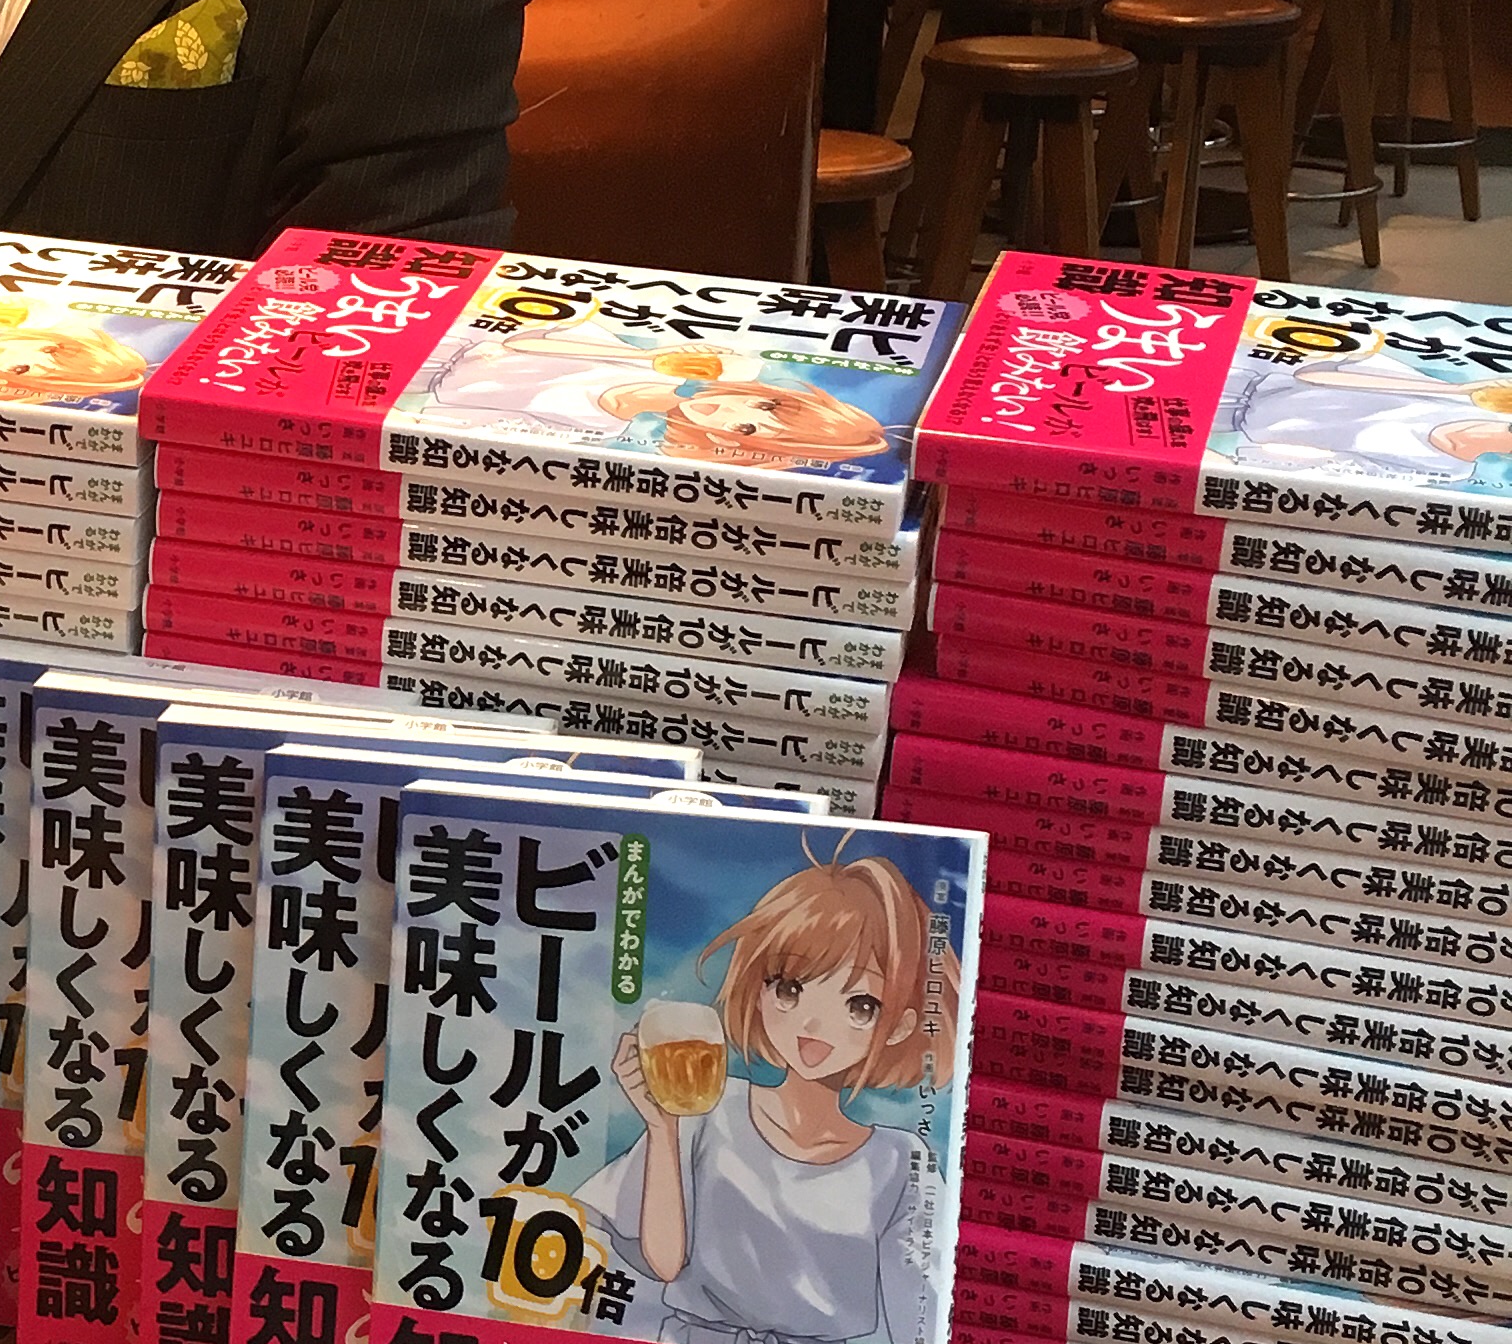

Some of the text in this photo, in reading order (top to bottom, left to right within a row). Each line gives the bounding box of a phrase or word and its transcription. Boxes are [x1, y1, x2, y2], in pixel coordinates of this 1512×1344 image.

[322, 273, 458, 356] うまい
[469, 286, 923, 367] ビールが10倍
[1092, 300, 1225, 393] うまい
[389, 433, 825, 522] ビールが10倍美味しくなる知識
[408, 483, 843, 566] ビールが10倍美味しくなる知識
[408, 532, 843, 615] ビールが10倍美味しくなる知識
[398, 581, 828, 667] ビールが10倍美味しくなる知識
[387, 629, 812, 718] ビールが10倍美味しくなる知識
[618, 841, 643, 995] まんがでわかる
[923, 913, 950, 1038] 藤原ヒロユキ
[36, 716, 127, 1326] 美味しくなる知識
[477, 836, 637, 1326] ビールが10倍
